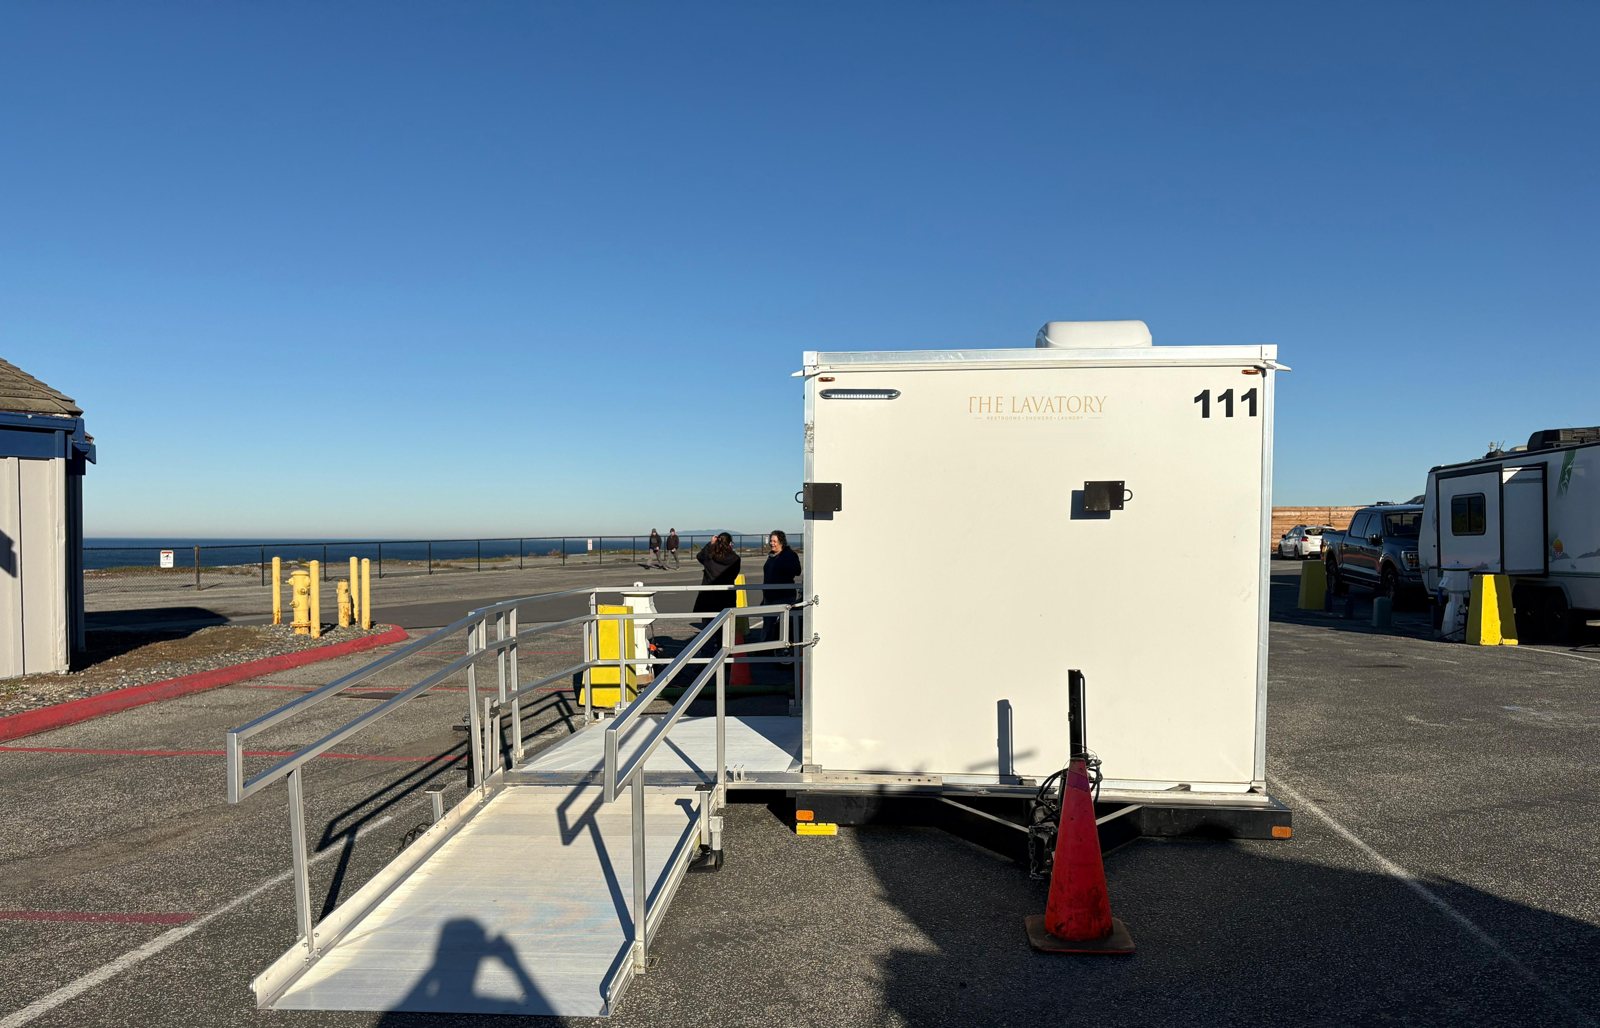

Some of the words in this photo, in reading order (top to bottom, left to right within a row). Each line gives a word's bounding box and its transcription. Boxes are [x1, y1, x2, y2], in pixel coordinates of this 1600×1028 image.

[968, 395, 1004, 414] THE
[1011, 395, 1107, 414] LAVATORY
[1194, 387, 1257, 418] 111
